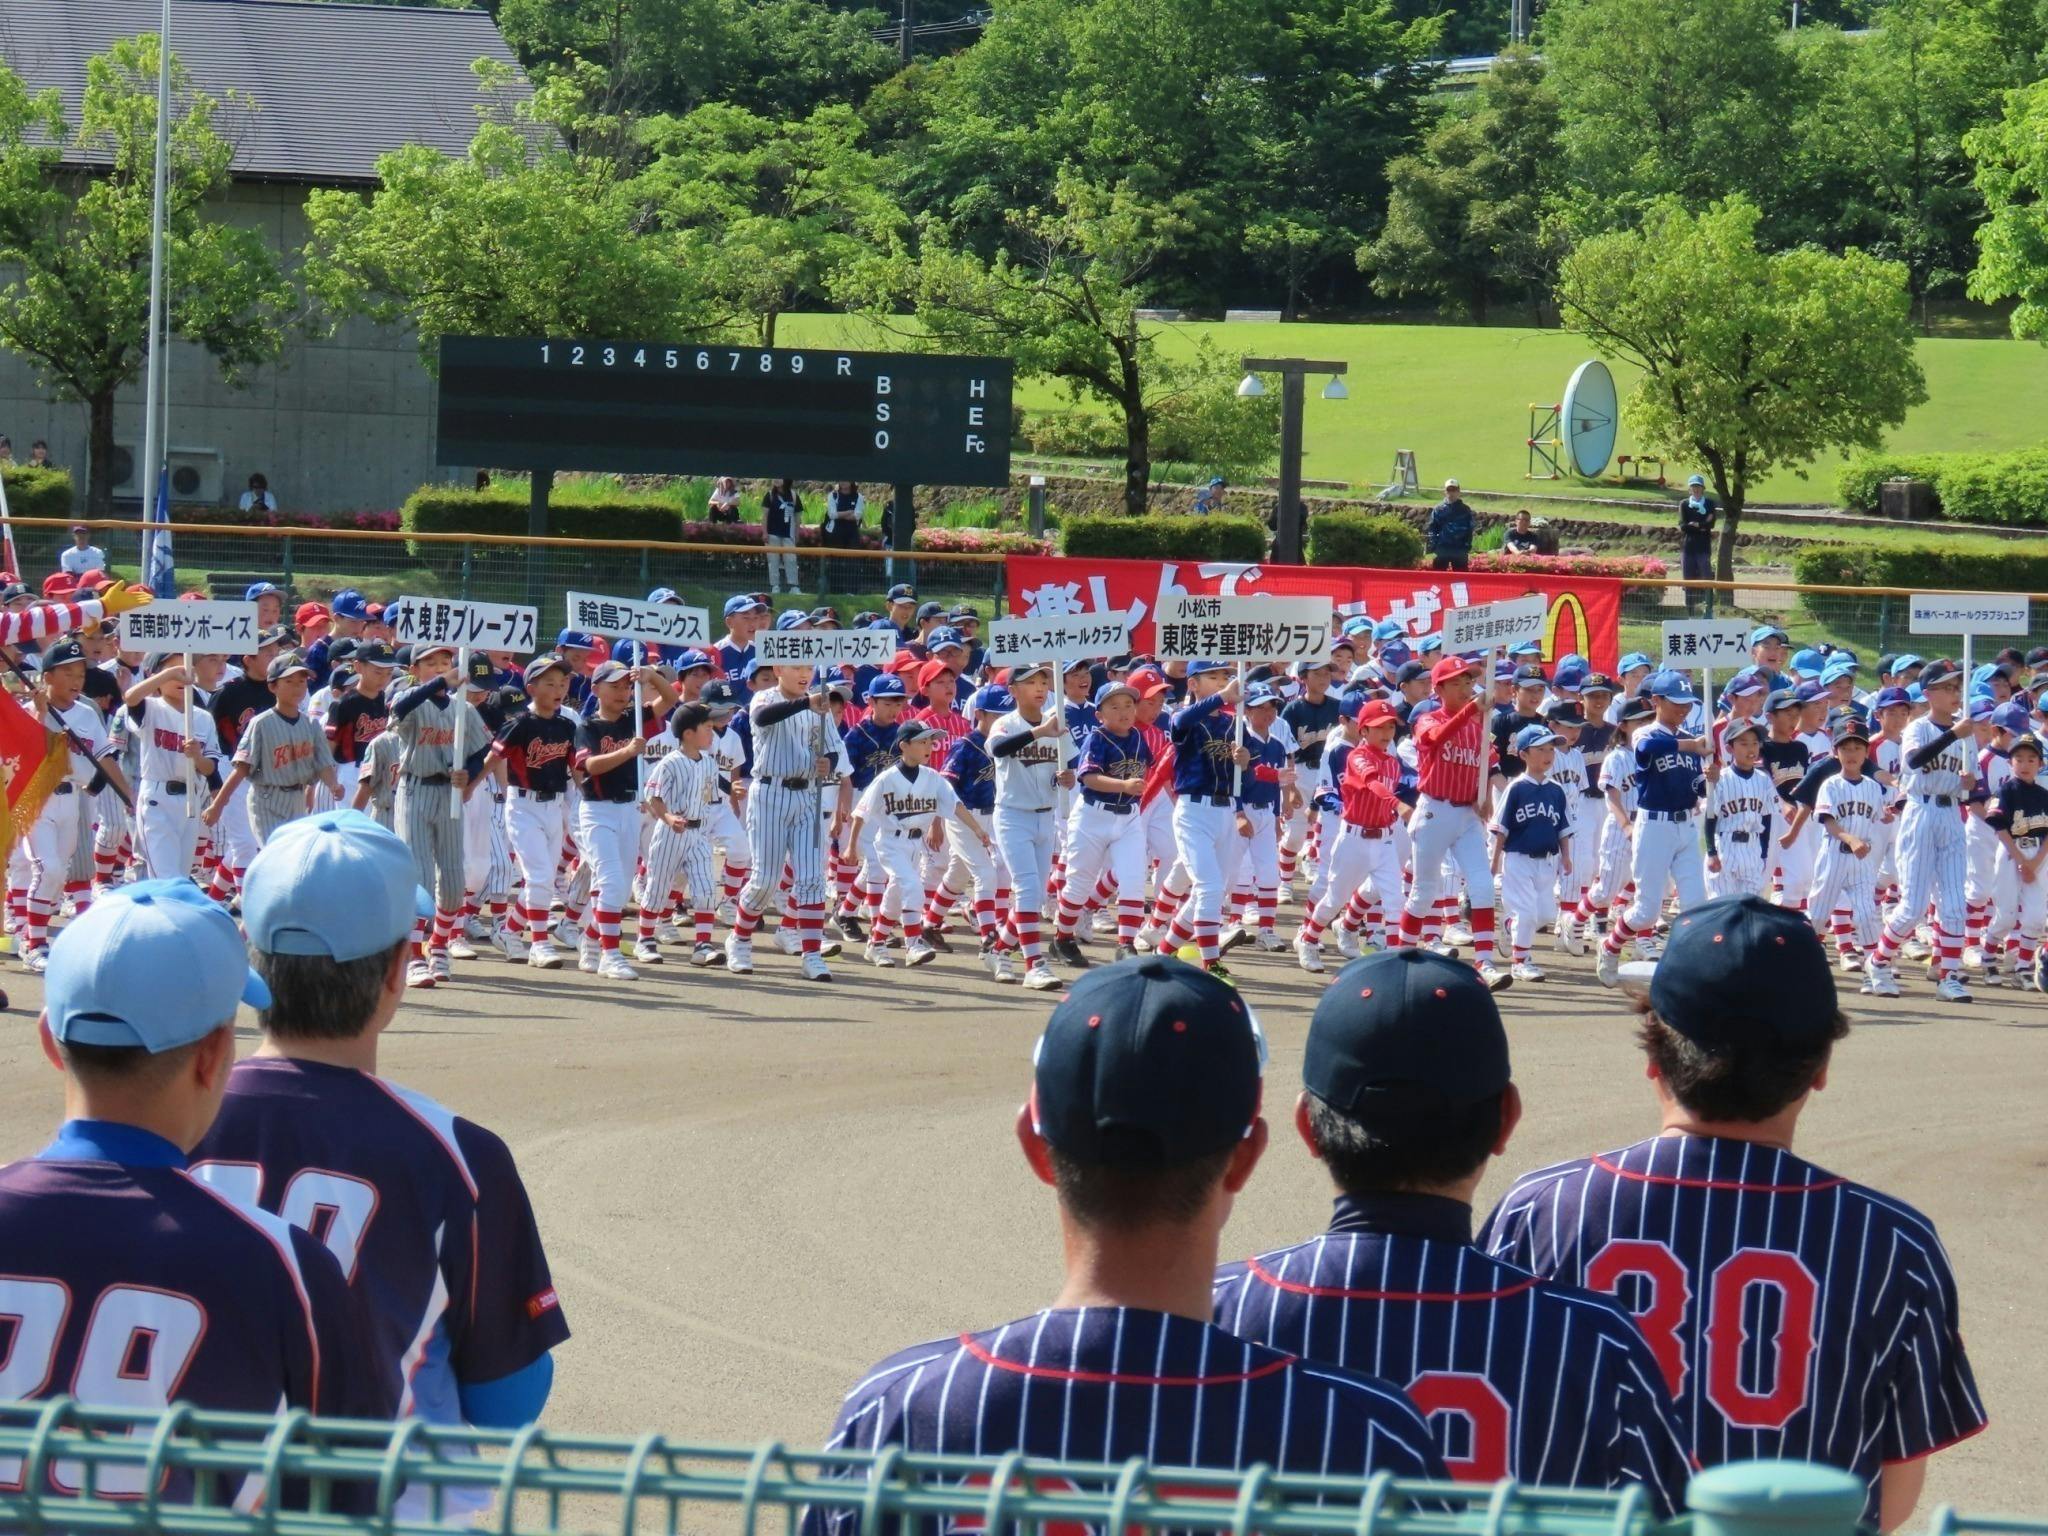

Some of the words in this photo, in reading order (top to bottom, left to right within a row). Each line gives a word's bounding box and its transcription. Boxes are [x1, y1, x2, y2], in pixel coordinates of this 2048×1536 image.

[541, 346, 549, 363] 1
[571, 347, 584, 365] 2
[603, 348, 615, 366] 3
[634, 350, 646, 367] 4
[665, 351, 678, 369] 5
[696, 352, 709, 370] 6
[728, 353, 740, 371] 7
[759, 354, 772, 373] 8
[791, 356, 804, 374] 9
[837, 358, 851, 376] R
[876, 376, 891, 394] B
[970, 380, 985, 398] H
[876, 404, 890, 422] S
[969, 408, 984, 426] E
[965, 435, 985, 453] Fc
[578, 600, 702, 641] 輪島フェニックス
[1177, 598, 1222, 618] 小松市
[128, 613, 251, 641] 西南部サンボーイズ
[399, 600, 534, 647] 木曳野ブレーブス
[1454, 612, 1542, 644] 志賀学童野球クラブ
[69, 643, 80, 657] S
[994, 624, 1122, 654] 宝達ベースボールクラブ
[1160, 621, 1330, 657] 東陵学童野球クラブ
[1668, 632, 1747, 657] 東湊ベアーズ
[1680, 680, 1691, 692] H
[1515, 801, 1562, 827] BEARS
